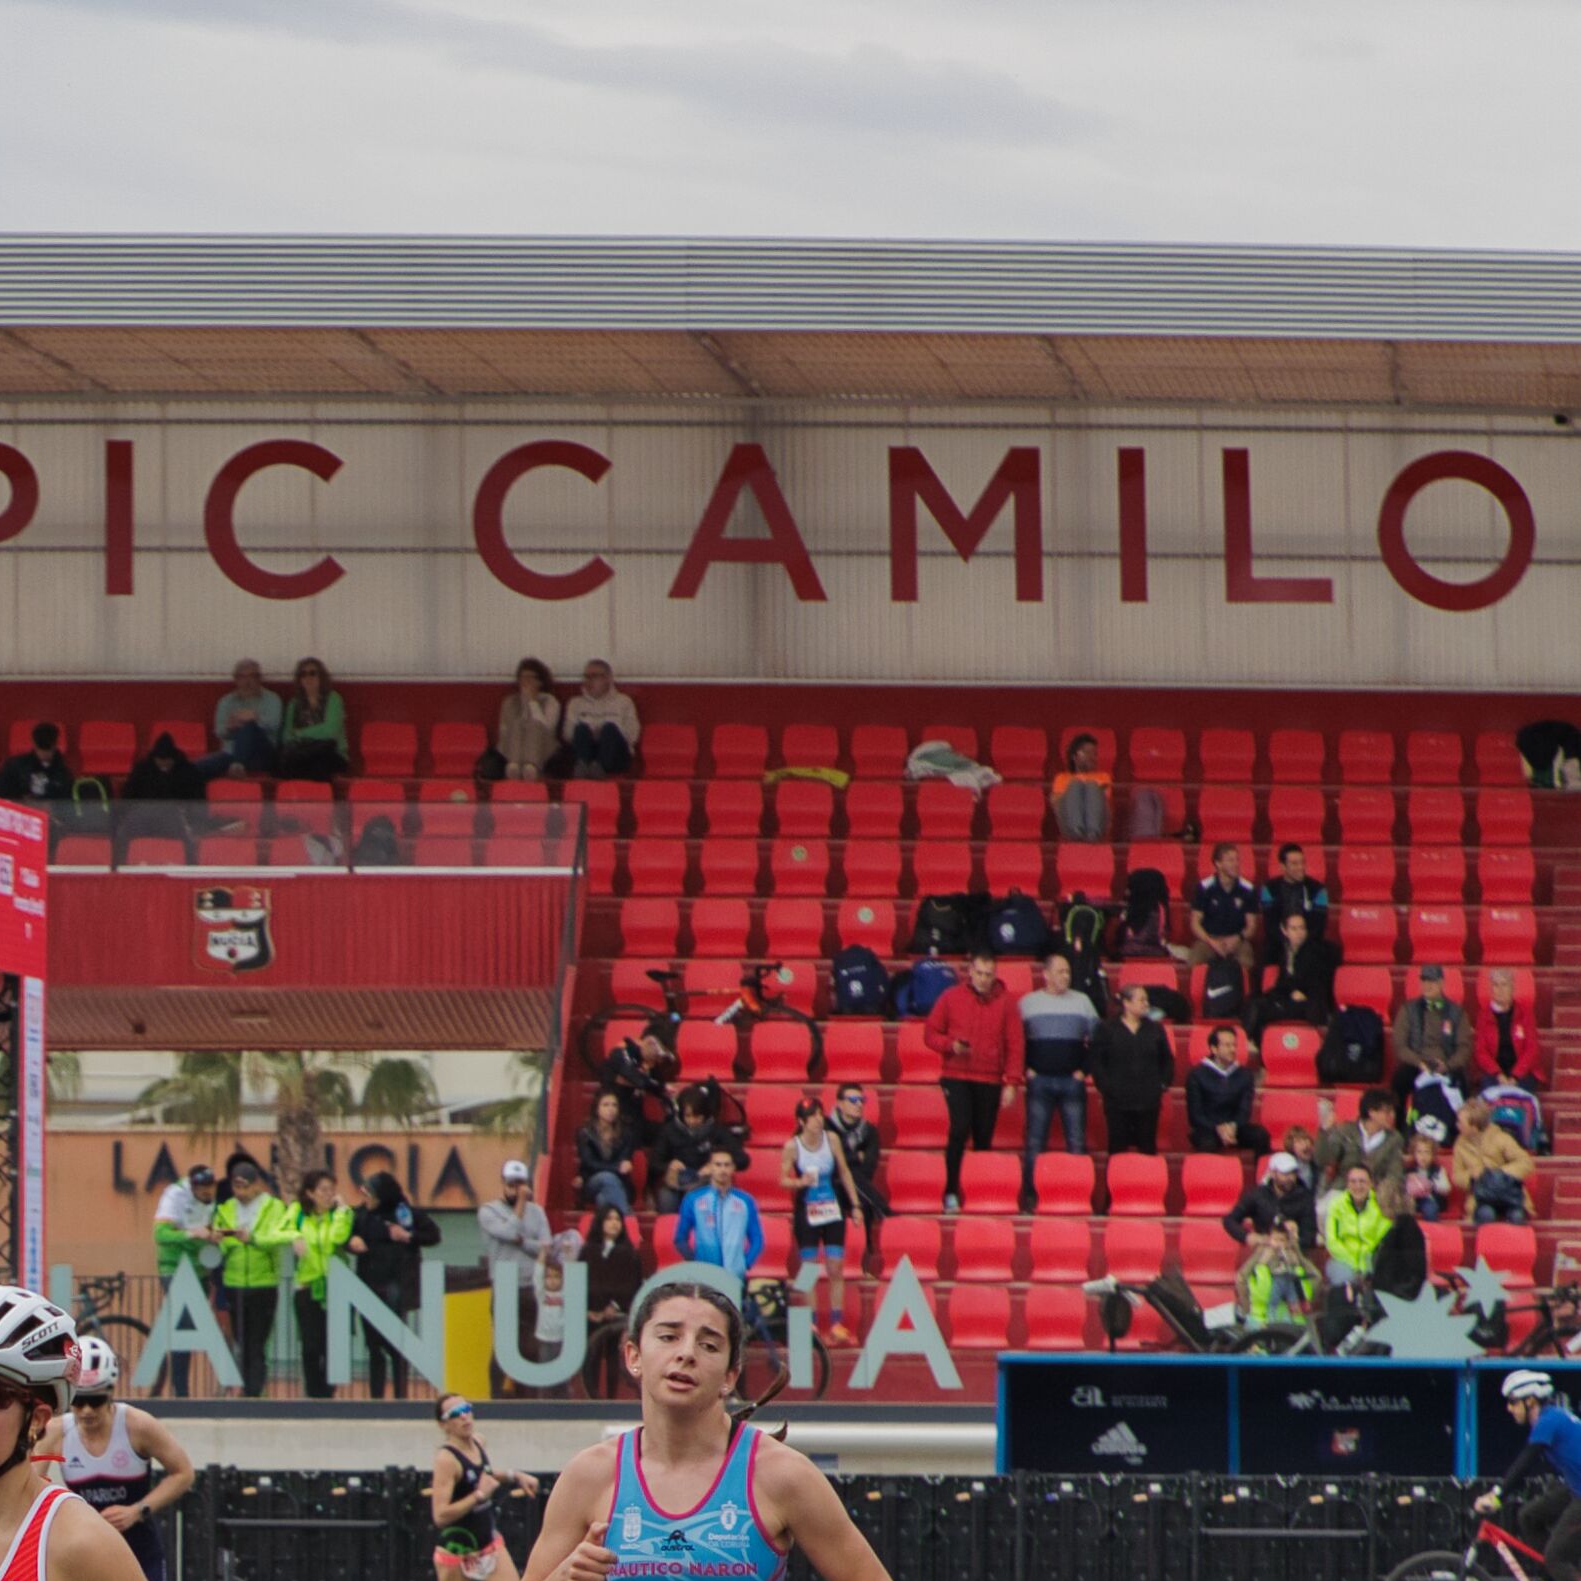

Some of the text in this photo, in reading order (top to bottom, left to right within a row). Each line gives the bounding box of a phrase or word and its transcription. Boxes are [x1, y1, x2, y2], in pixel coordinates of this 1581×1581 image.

[472, 439, 1536, 613] CAMILO
[20, 1321, 60, 1349] SCOTT
[688, 1563, 758, 1577] NARON
